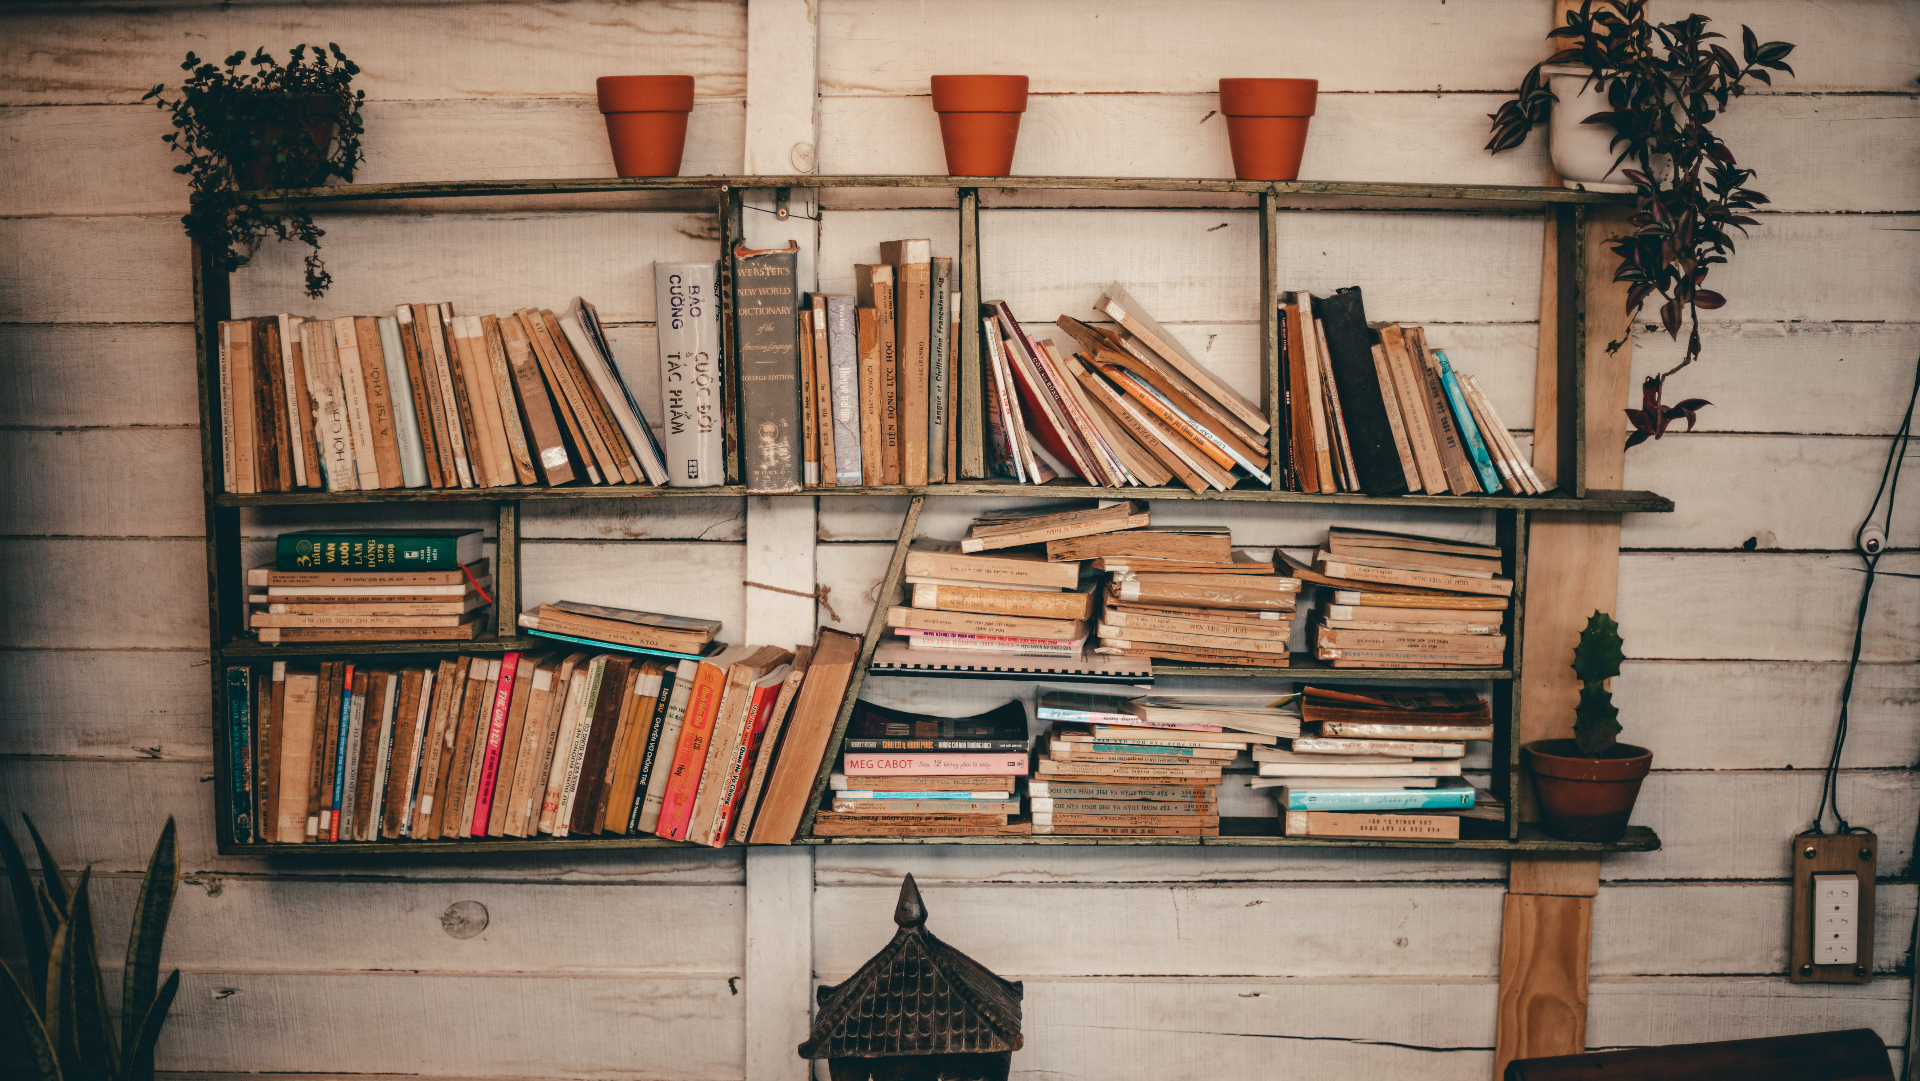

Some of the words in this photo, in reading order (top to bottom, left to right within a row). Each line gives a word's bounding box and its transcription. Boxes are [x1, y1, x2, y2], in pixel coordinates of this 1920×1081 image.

[737, 267, 791, 277] WEBSTER'S
[737, 287, 757, 296] NEW
[759, 287, 791, 296] WORLD
[668, 273, 685, 329] CƯỜNG
[687, 284, 705, 317] BẢO
[738, 306, 792, 316] DICTIONARY
[755, 323, 765, 336] of
[764, 322, 775, 332] the
[740, 341, 769, 353] American
[763, 341, 794, 354] Language
[884, 340, 895, 362] HỌC
[666, 351, 687, 382] TÁC
[689, 351, 715, 397] CUỘC
[440, 368, 448, 382] VĂN
[741, 374, 767, 382] COLLEGE
[838, 366, 852, 384] Hiểu
[884, 366, 895, 387] LỰC
[839, 394, 853, 408] trái
[885, 390, 897, 419] ĐỘNG
[668, 388, 692, 435] PHẨM
[840, 408, 854, 422] tim
[934, 395, 944, 425] Langue
[695, 404, 717, 433] ĐỜI
[887, 424, 898, 447] ĐIỆN
[325, 542, 336, 563] VĂN
[353, 542, 363, 565] LÂM
[364, 539, 376, 568] ĐỒNG
[377, 543, 385, 563] 1978
[387, 543, 396, 564] 2008
[496, 688, 510, 710] THẾ
[492, 708, 506, 729] GIỚI
[352, 726, 360, 738] TÂY
[650, 716, 662, 741] CHUYỆN
[432, 731, 442, 746] NAM
[463, 736, 473, 753] HỌC
[489, 726, 503, 748] YÊU
[547, 730, 556, 745] NAM
[349, 738, 359, 766] PHƯƠNG
[430, 747, 440, 761] VIỆT
[544, 745, 553, 760] VIỆT
[568, 739, 580, 768] ĐƯỜNG
[647, 741, 655, 752] VỢ
[735, 745, 747, 764] Quan
[576, 750, 584, 761] VÀ
[641, 750, 654, 773] CHỒNG
[849, 758, 873, 768] MEG
[876, 758, 913, 768] CABOT
[933, 758, 942, 767] 12
[348, 766, 357, 780] HỌC
[458, 755, 469, 775] TOÁN
[426, 772, 436, 788] LỊCH
[539, 770, 548, 786] LỊCH
[563, 769, 574, 793] DỤNG
[639, 772, 648, 786] TRẺ
[729, 773, 739, 783] Vợ
[347, 781, 355, 793] VĂN
[723, 783, 737, 806] Chồng
[1063, 787, 1076, 795] VĂN
[1110, 788, 1117, 796] VÀ
[1137, 789, 1154, 797] NGHỊ
[1156, 790, 1168, 798] TẬP
[542, 801, 560, 814] 238
[560, 793, 569, 806] SỬ
